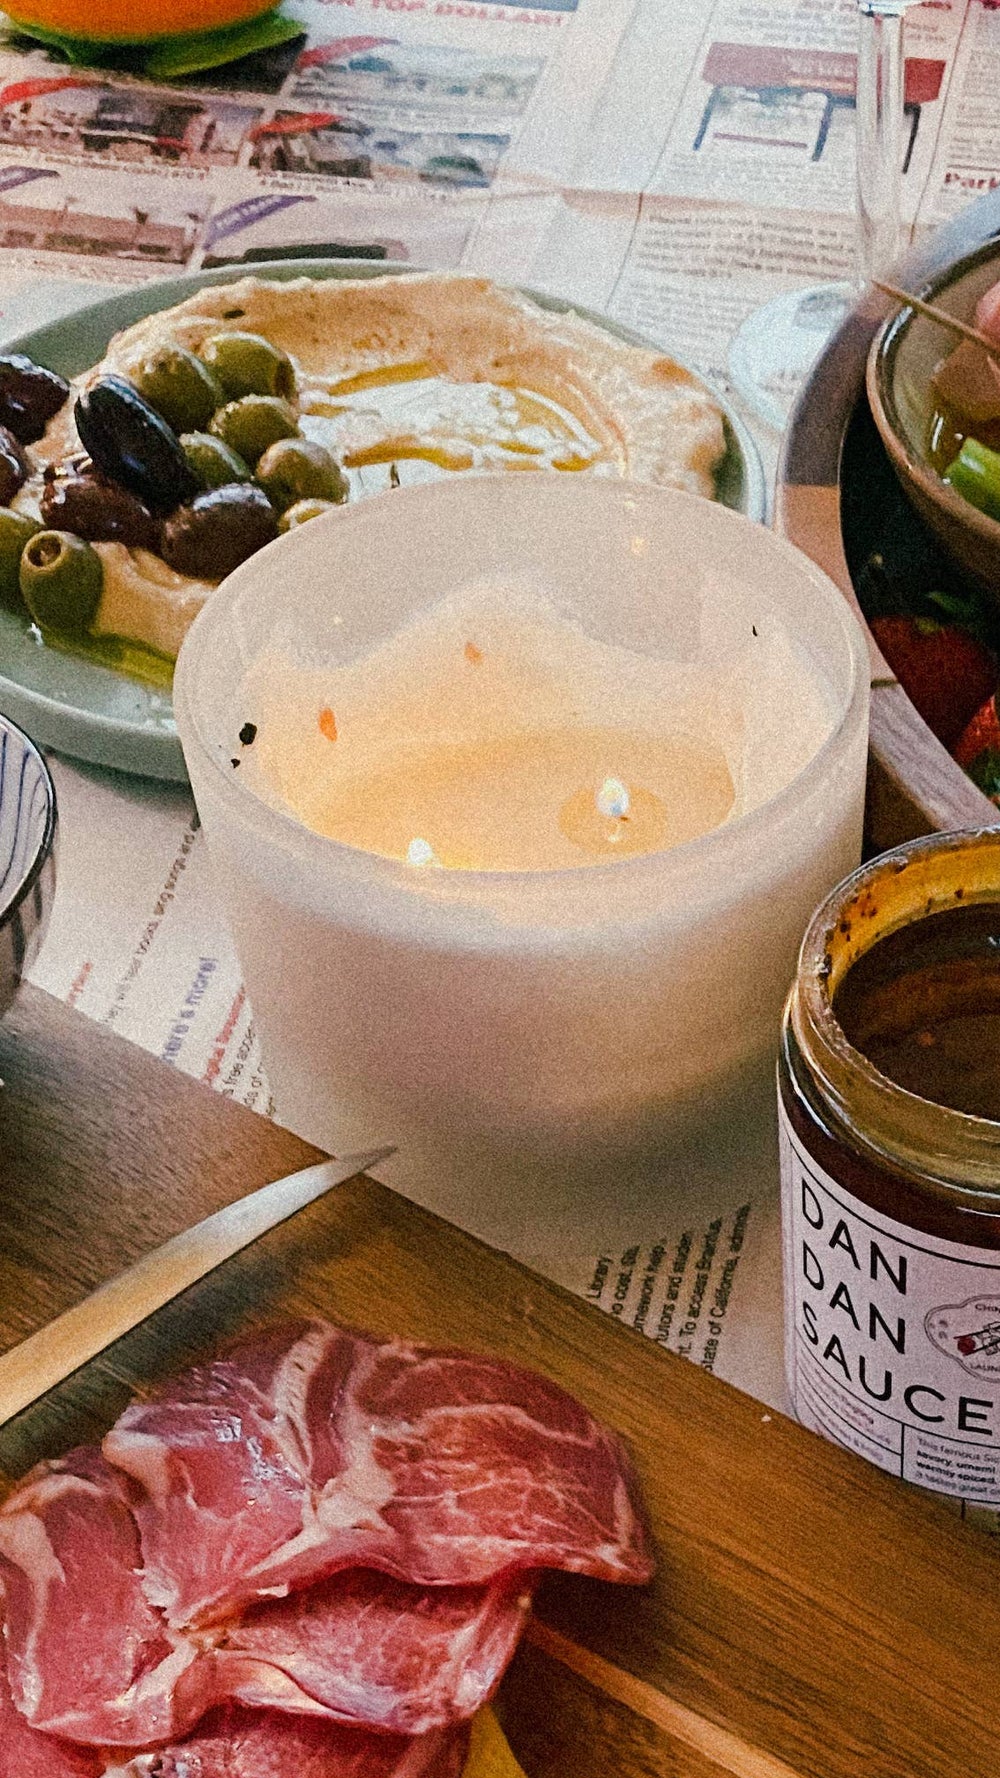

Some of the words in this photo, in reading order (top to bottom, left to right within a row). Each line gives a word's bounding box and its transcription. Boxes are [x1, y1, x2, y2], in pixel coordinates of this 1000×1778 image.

[801, 1177, 908, 1296] DAN
[679, 1322, 696, 1337] To
[708, 1321, 722, 1334] of
[802, 1239, 906, 1355] DAN
[802, 1301, 994, 1436] SAUCE
